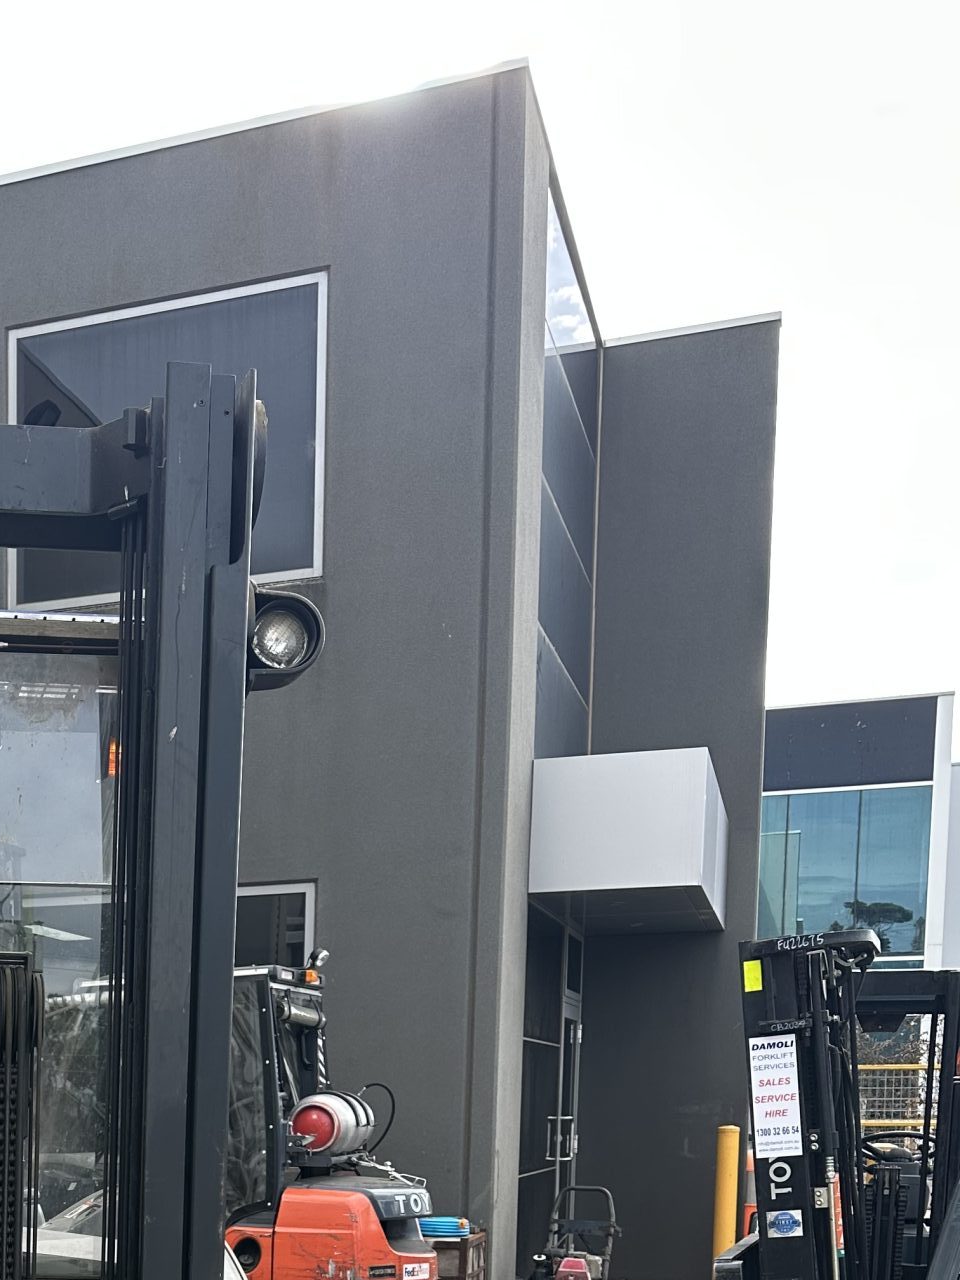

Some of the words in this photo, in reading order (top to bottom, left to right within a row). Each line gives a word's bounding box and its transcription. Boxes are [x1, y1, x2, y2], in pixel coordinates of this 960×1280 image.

[751, 1039, 794, 1051] DAMOLI
[752, 1052, 794, 1062] FORKLIFT
[753, 1062, 795, 1072] SERVICES
[758, 1077, 791, 1087] SALES
[754, 1093, 797, 1104] SERVICE
[765, 1109, 789, 1118] HIRE
[756, 1127, 772, 1137] 1300
[773, 1127, 781, 1136] 32
[782, 1126, 790, 1135] 66
[791, 1125, 800, 1134] 54
